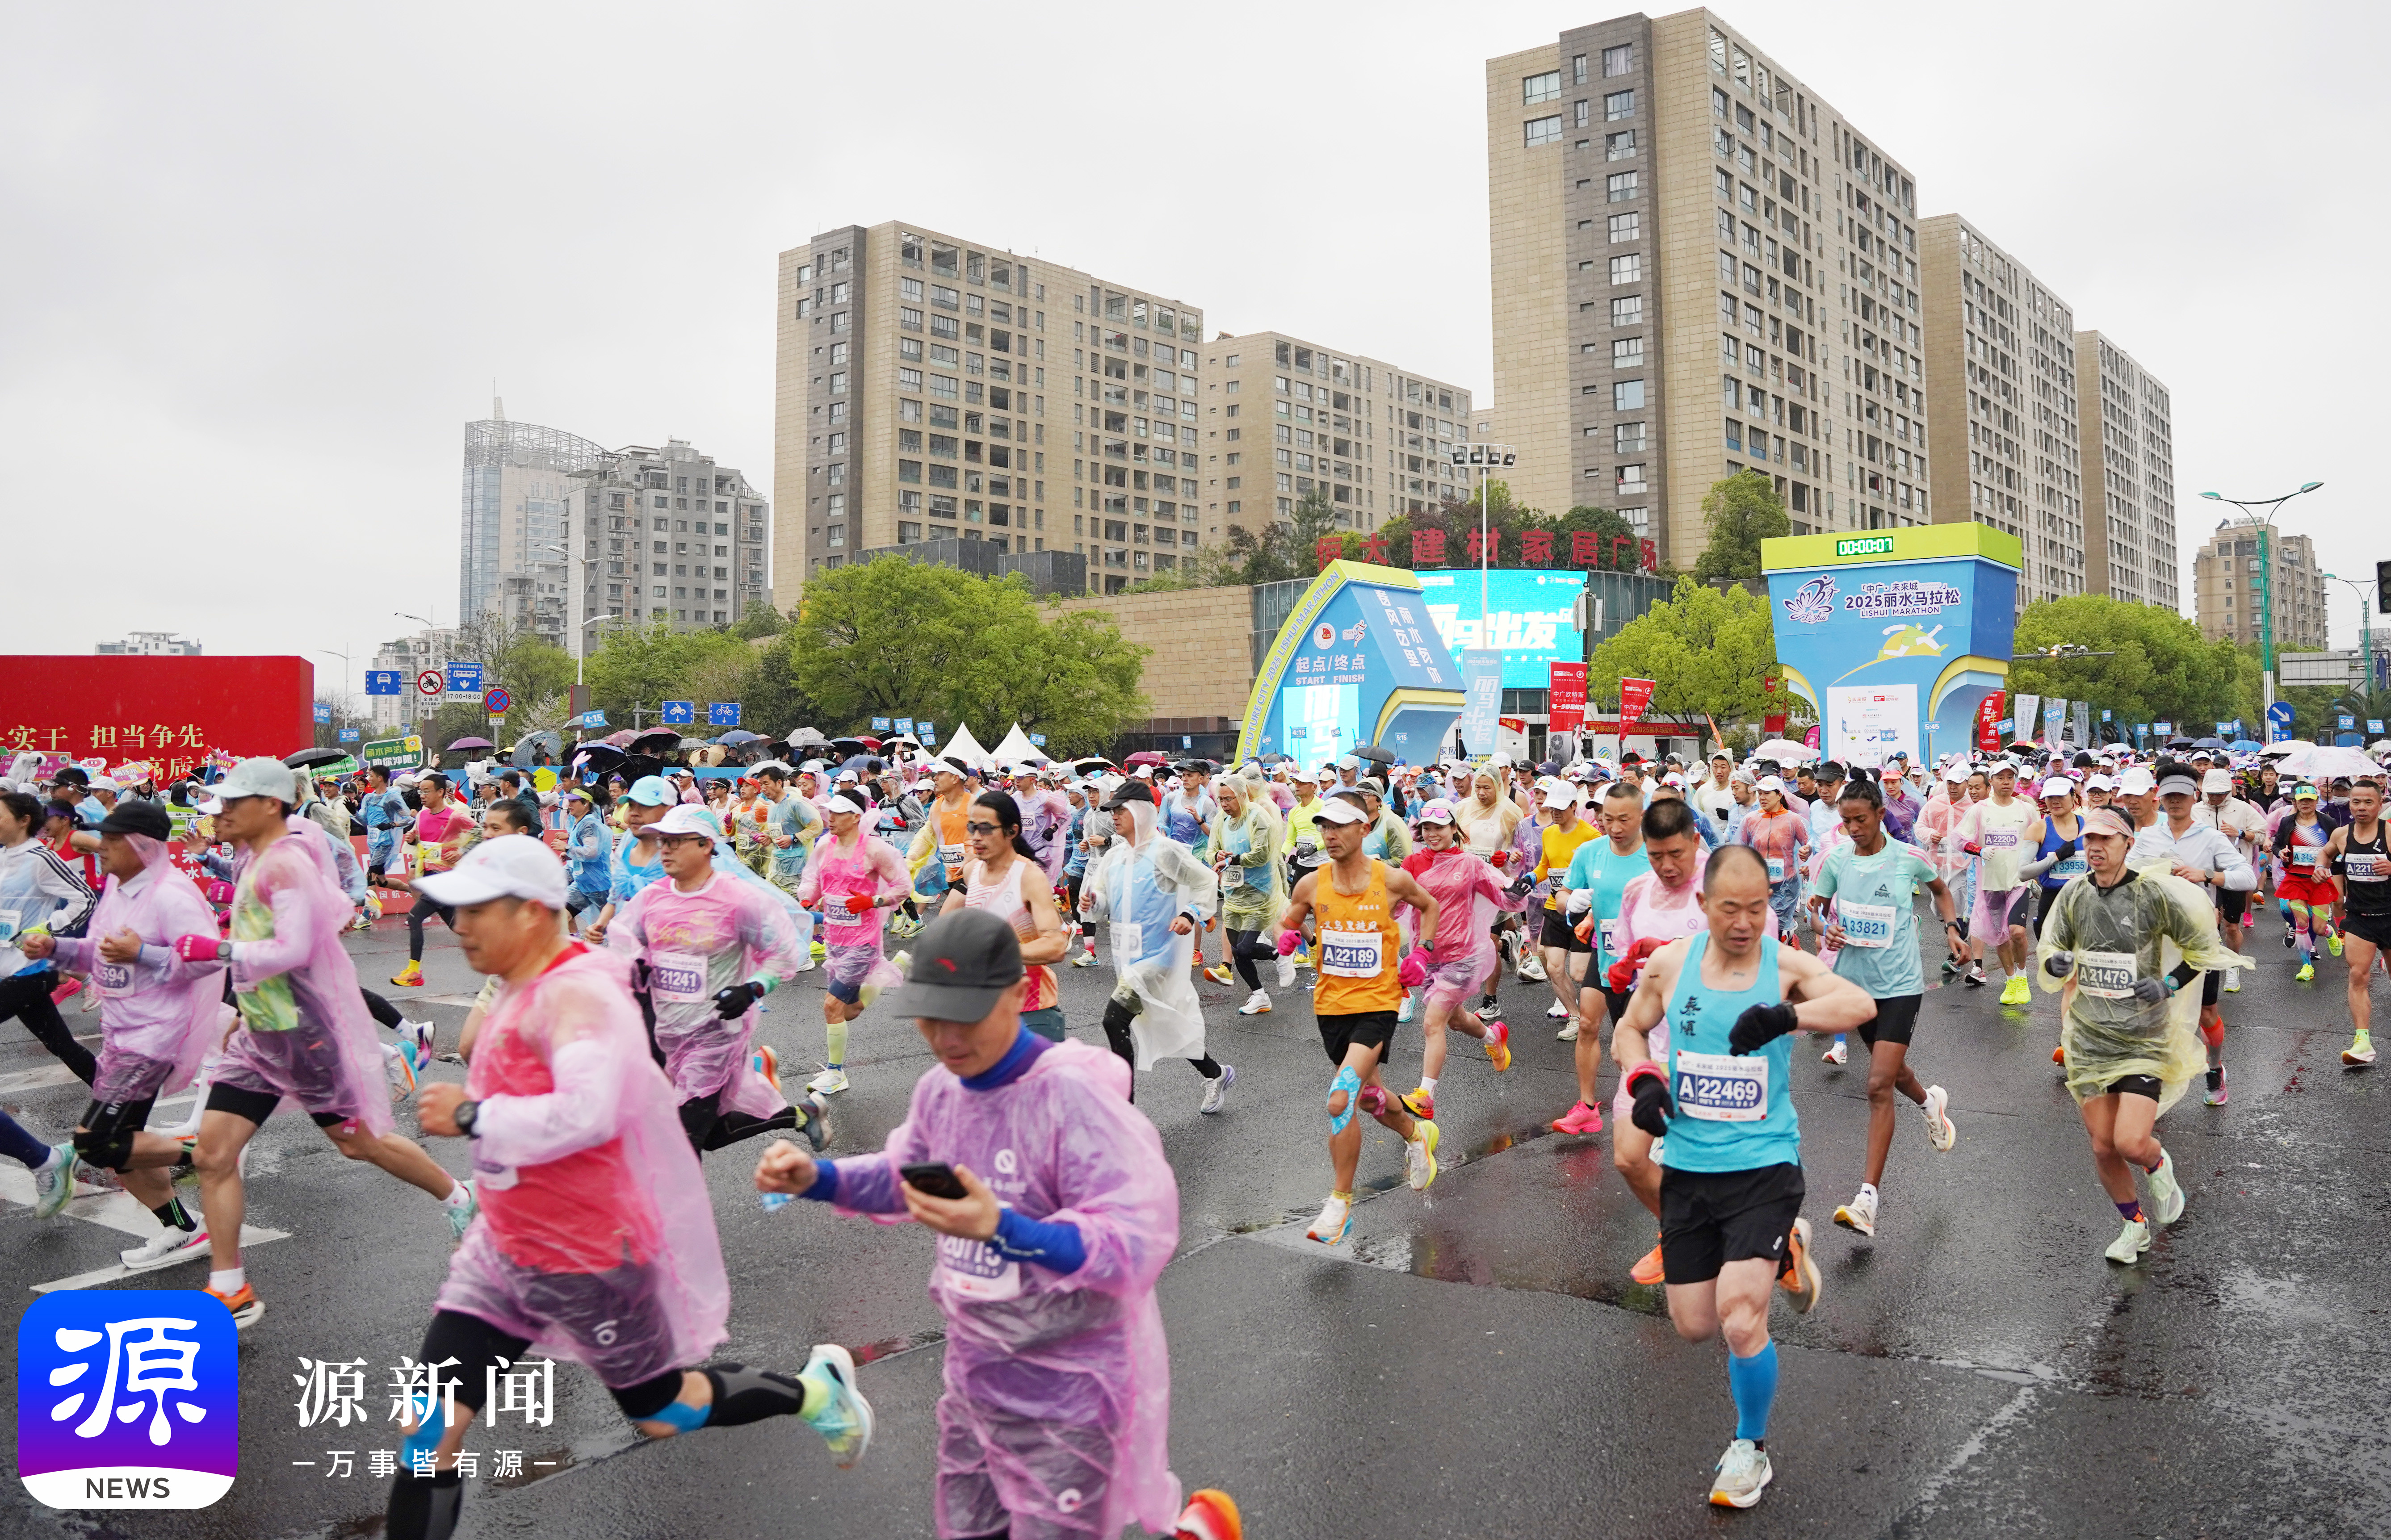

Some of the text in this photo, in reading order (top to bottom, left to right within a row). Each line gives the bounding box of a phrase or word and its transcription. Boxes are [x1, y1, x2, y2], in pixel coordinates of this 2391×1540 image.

[1316, 527, 1656, 572] 恒大建材家居广场
[1839, 538, 1893, 555] 00:00:07
[1846, 589, 1959, 609] 2025丽水马拉松
[1862, 607, 1939, 617] LISHUI MARATHON
[1245, 704, 1262, 746] FUTURE
[1257, 679, 1271, 705] CITY
[1266, 654, 1282, 682] 2025
[1277, 623, 1300, 657] LISHUI
[1295, 570, 1340, 626] MARATHON
[1296, 653, 1366, 674] 起点/终点
[1296, 674, 1365, 685] START FINISH
[585, 714, 603, 723] 4:15
[2046, 710, 2060, 719] 4:00
[897, 721, 911, 729] 4:15
[1998, 721, 2013, 730] 4:00
[0, 724, 205, 750] 实干 担当争先
[1986, 834, 2016, 845] A22204
[2347, 863, 2375, 873] A221
[1842, 917, 1886, 935] A33821
[1324, 946, 1375, 963] A22189
[2080, 966, 2129, 984] A21479
[1679, 1075, 1758, 1101] A22469
